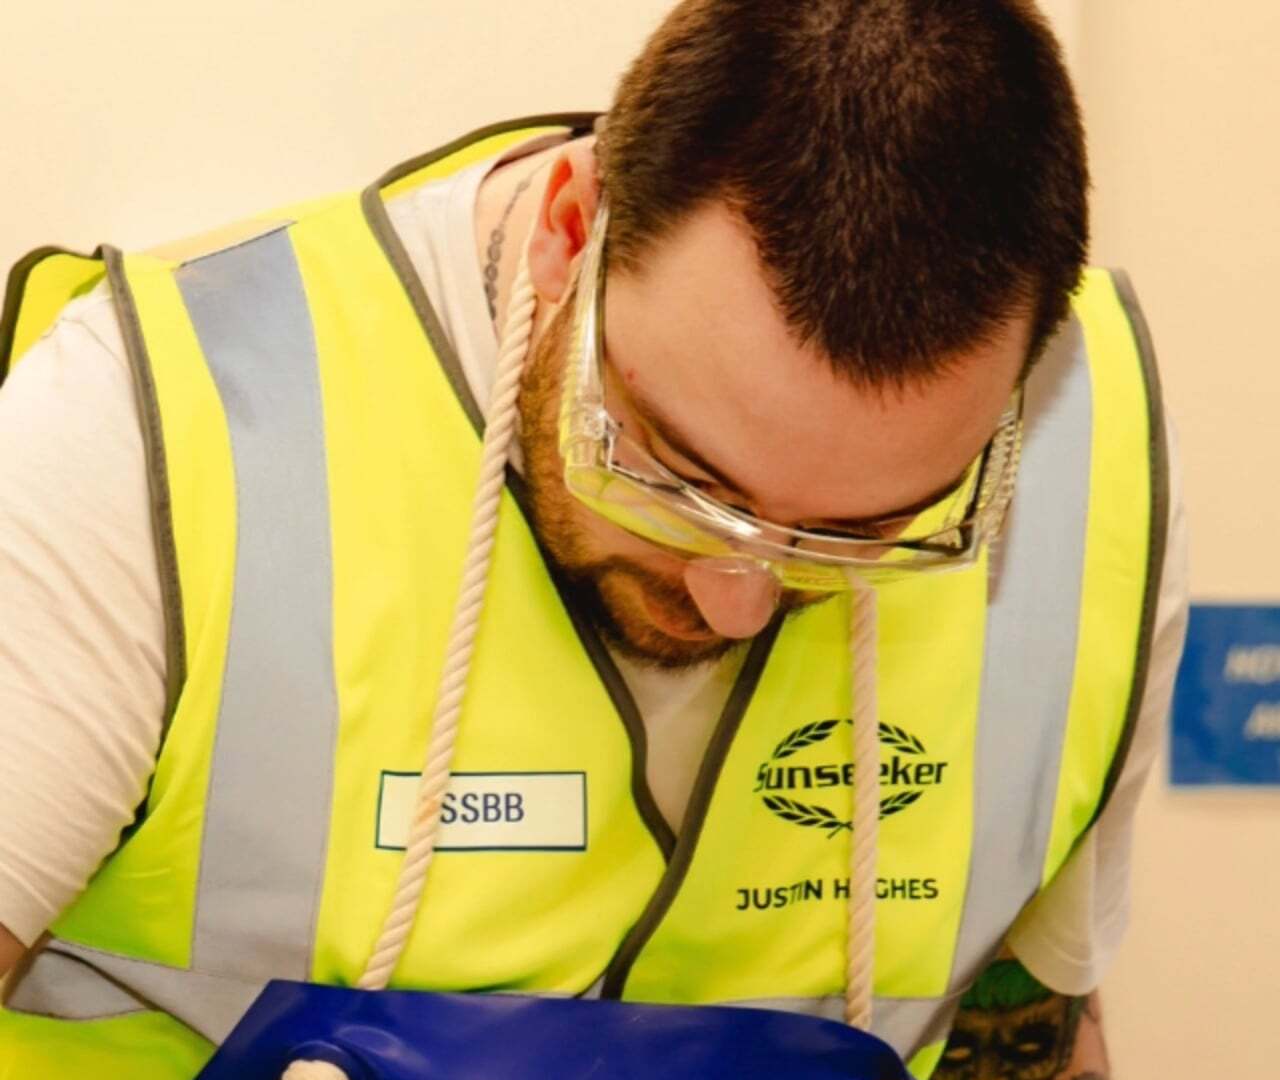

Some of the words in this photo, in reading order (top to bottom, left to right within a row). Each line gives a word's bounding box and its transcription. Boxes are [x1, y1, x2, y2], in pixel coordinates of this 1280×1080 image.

[439, 792, 525, 824] SSBB
[735, 879, 823, 911] JUSTIN
[833, 878, 939, 900] HGHES
